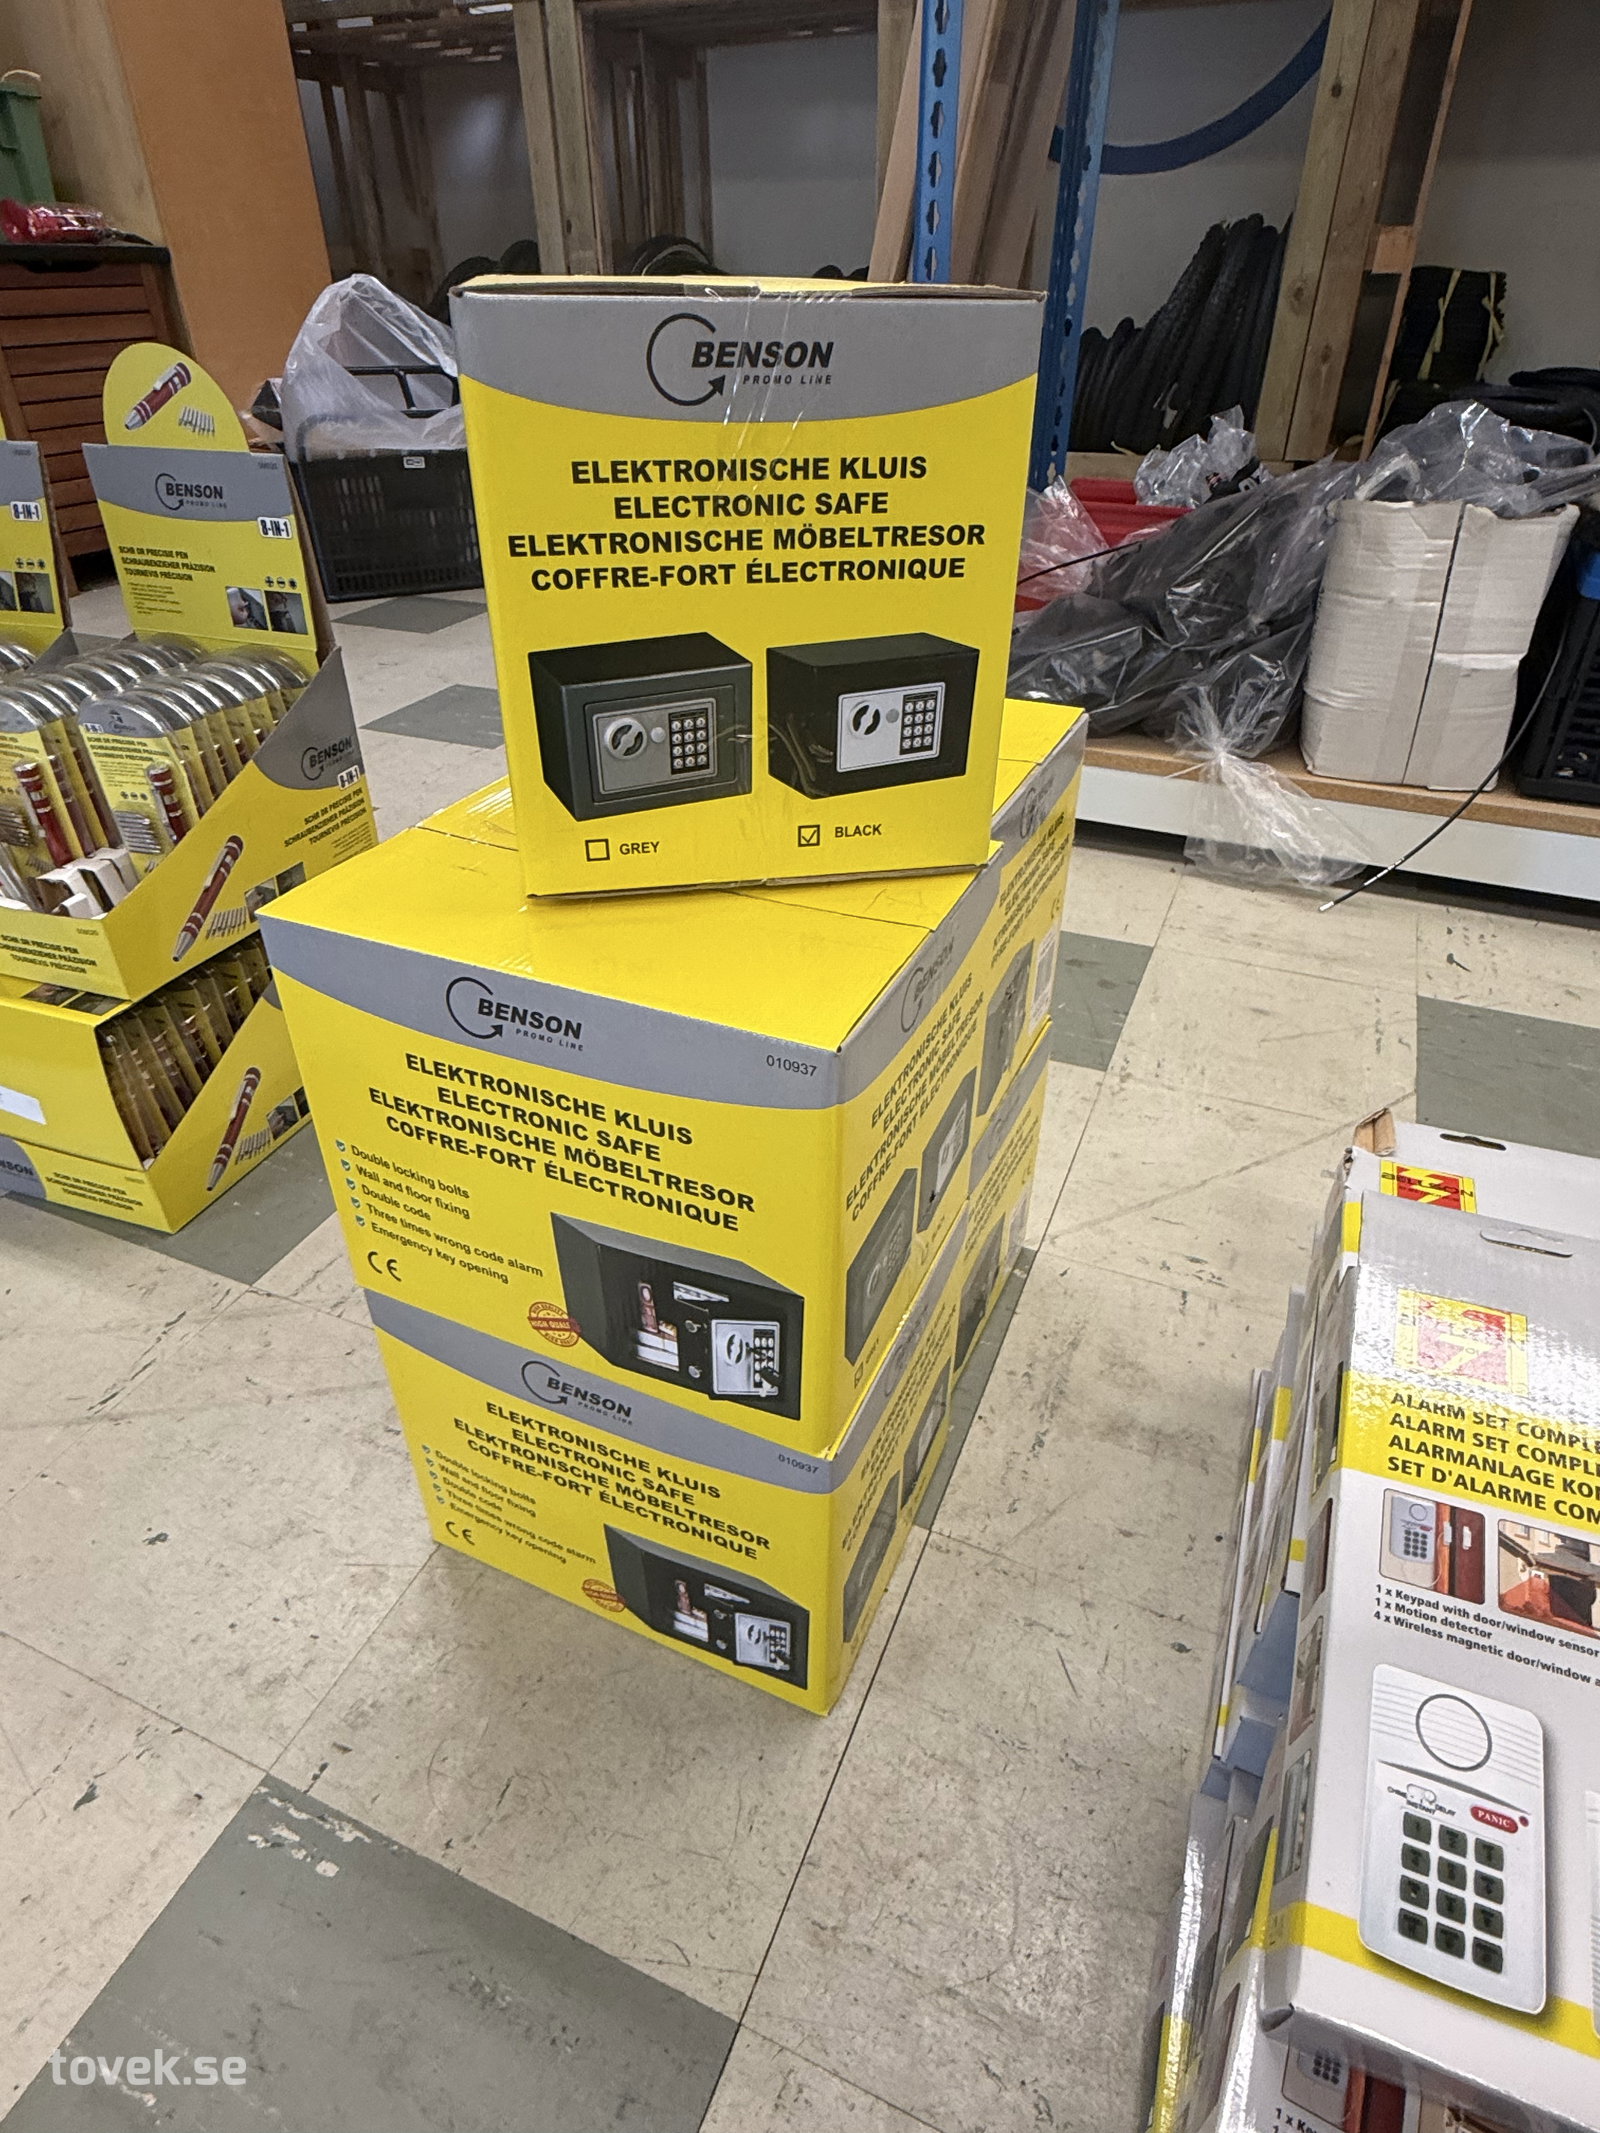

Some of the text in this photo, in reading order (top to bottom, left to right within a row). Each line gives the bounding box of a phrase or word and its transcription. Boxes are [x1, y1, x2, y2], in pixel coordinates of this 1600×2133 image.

[692, 340, 834, 369] BENSON
[743, 374, 833, 385] PROMO LINE
[166, 482, 223, 499] BENSON
[572, 455, 927, 484] ELEKTRONISCHE KLUIS
[613, 491, 888, 520] ELECTRONIC SAFE
[260, 519, 290, 537] 8-IN-1
[508, 523, 986, 558] ELEKTRONISCHE MÖBELTRESOR
[531, 556, 966, 593] COFFRE-FORT ÉLECTRONIQUE
[619, 840, 660, 856] GREY
[834, 823, 883, 838] BLACK
[477, 998, 583, 1039] BENSON
[516, 1028, 584, 1052] PROMO LINE
[766, 1054, 818, 1078] 010937
[405, 1053, 693, 1147] ELEKTRONISCHE KLUIS
[437, 1086, 661, 1163] ELECTRONIC SAFE
[369, 1087, 756, 1213] ELEKTRONISCHE MÖBELTRESOR
[351, 1144, 470, 1199] Double locking bolts
[355, 1164, 470, 1220] Wall and floor fixing
[386, 1115, 740, 1232] COFFRE-FORT ÉLECTRONIQUE
[361, 1184, 432, 1220] Double code
[366, 1202, 544, 1277] Three times wrong code alarm
[371, 1221, 509, 1285] Emergency key opening
[547, 1376, 632, 1418] BENSON
[1391, 1392, 1465, 1421] ALARM
[1473, 1411, 1509, 1431] SET
[486, 1402, 722, 1499] ELEKTRONISCHE KLUIS
[1389, 1412, 1465, 1444] ALARM
[1472, 1432, 1509, 1454] SET
[512, 1428, 695, 1506] ELECTRONIC SAFE
[1388, 1434, 1555, 1489] ALARMANLAGE
[454, 1418, 770, 1550] ELEKTRONISCHE MÖBELTRESOR
[467, 1439, 758, 1560] COFFRE-FORT ÉLECTRONIQUE
[1388, 1456, 1425, 1478] SET
[1431, 1467, 1546, 1511] D'ALARME
[1375, 1597, 1493, 1640] 1 x Motion detector
[1376, 1584, 1600, 1658] 1 x Keypad with door/window sensor
[1373, 1610, 1381, 1621] 4
[1384, 1615, 1392, 1624] x
[1393, 1616, 1444, 1640] Wireless
[1446, 1633, 1504, 1658] magnetic
[1506, 1649, 1591, 1684] door/window
[1477, 1810, 1510, 1828] PANIC
[1276, 2108, 1282, 2119] 1
